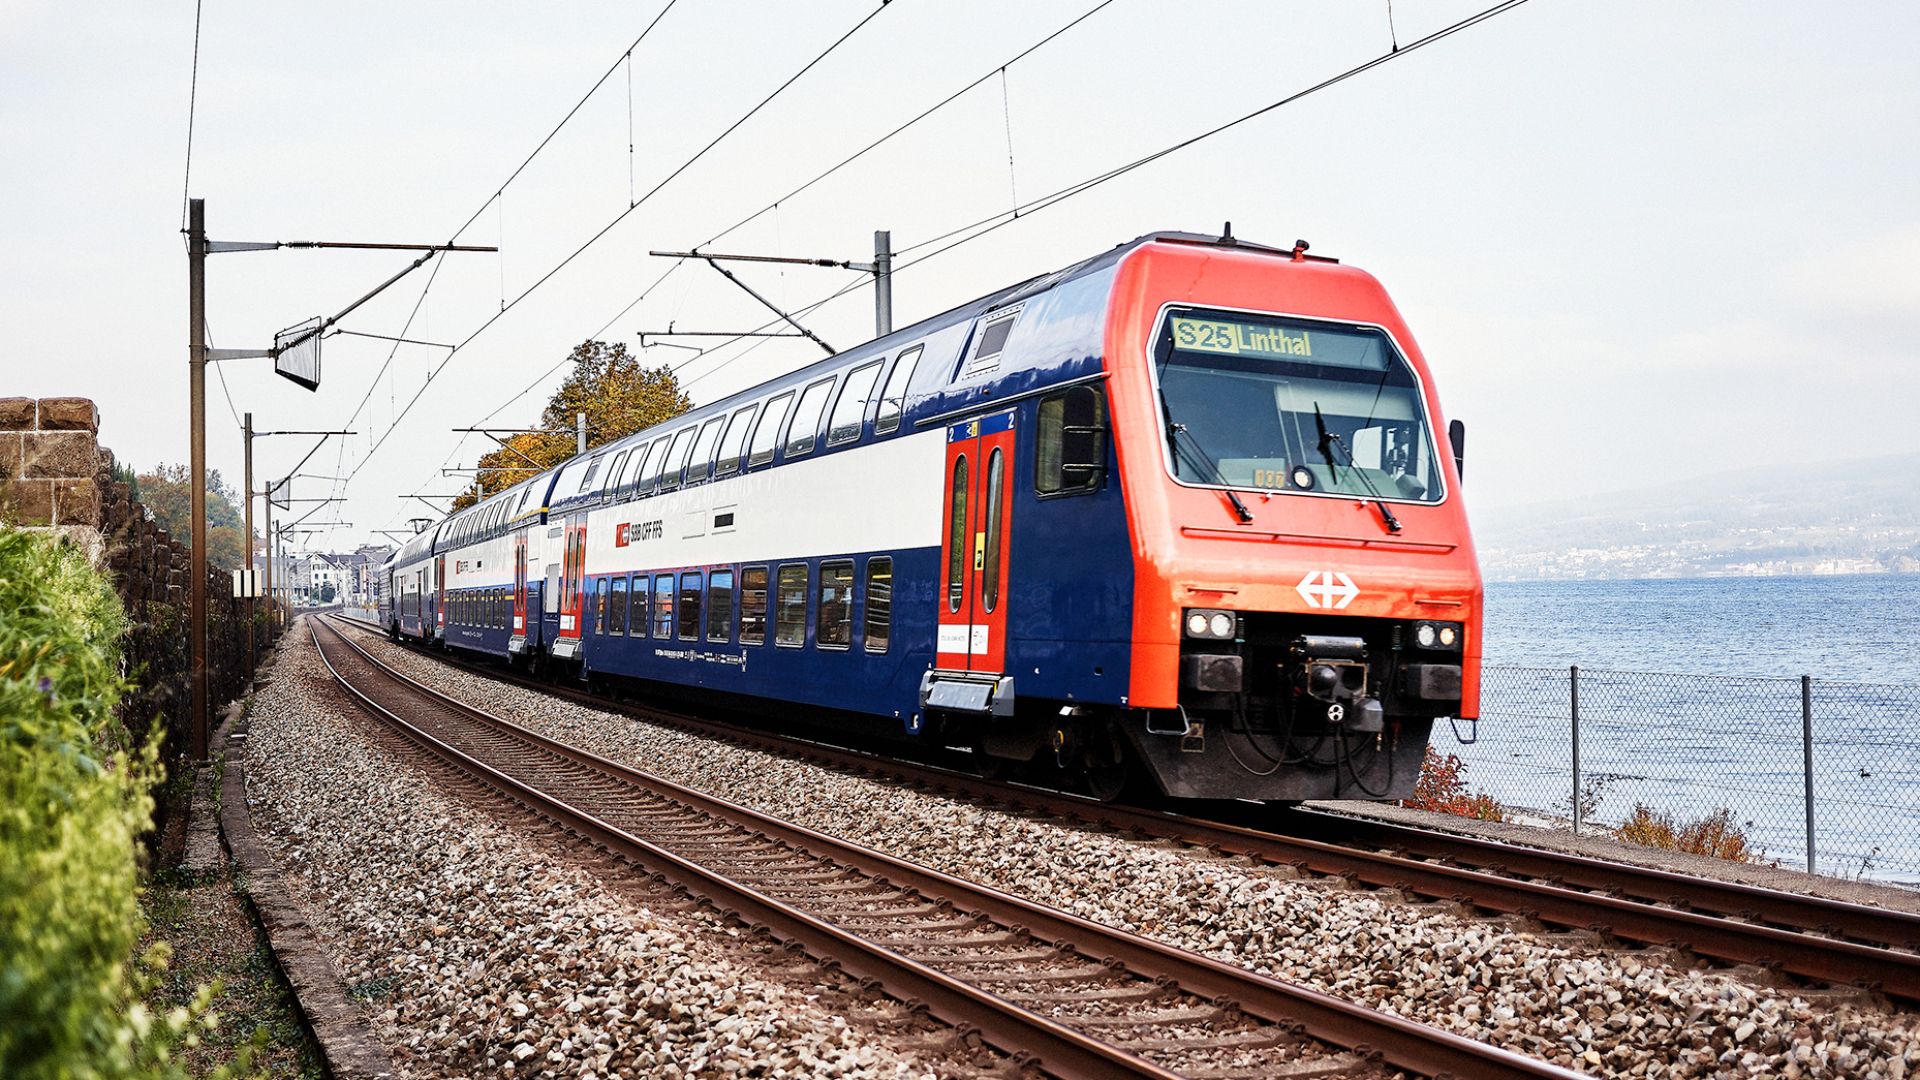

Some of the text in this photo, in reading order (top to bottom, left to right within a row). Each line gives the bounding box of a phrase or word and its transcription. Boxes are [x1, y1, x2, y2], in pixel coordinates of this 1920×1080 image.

[1178, 321, 1312, 357] S25 Linthal
[1008, 412, 1015, 430] 2
[948, 427, 955, 443] 2
[631, 519, 663, 542] SBB CFF FFS
